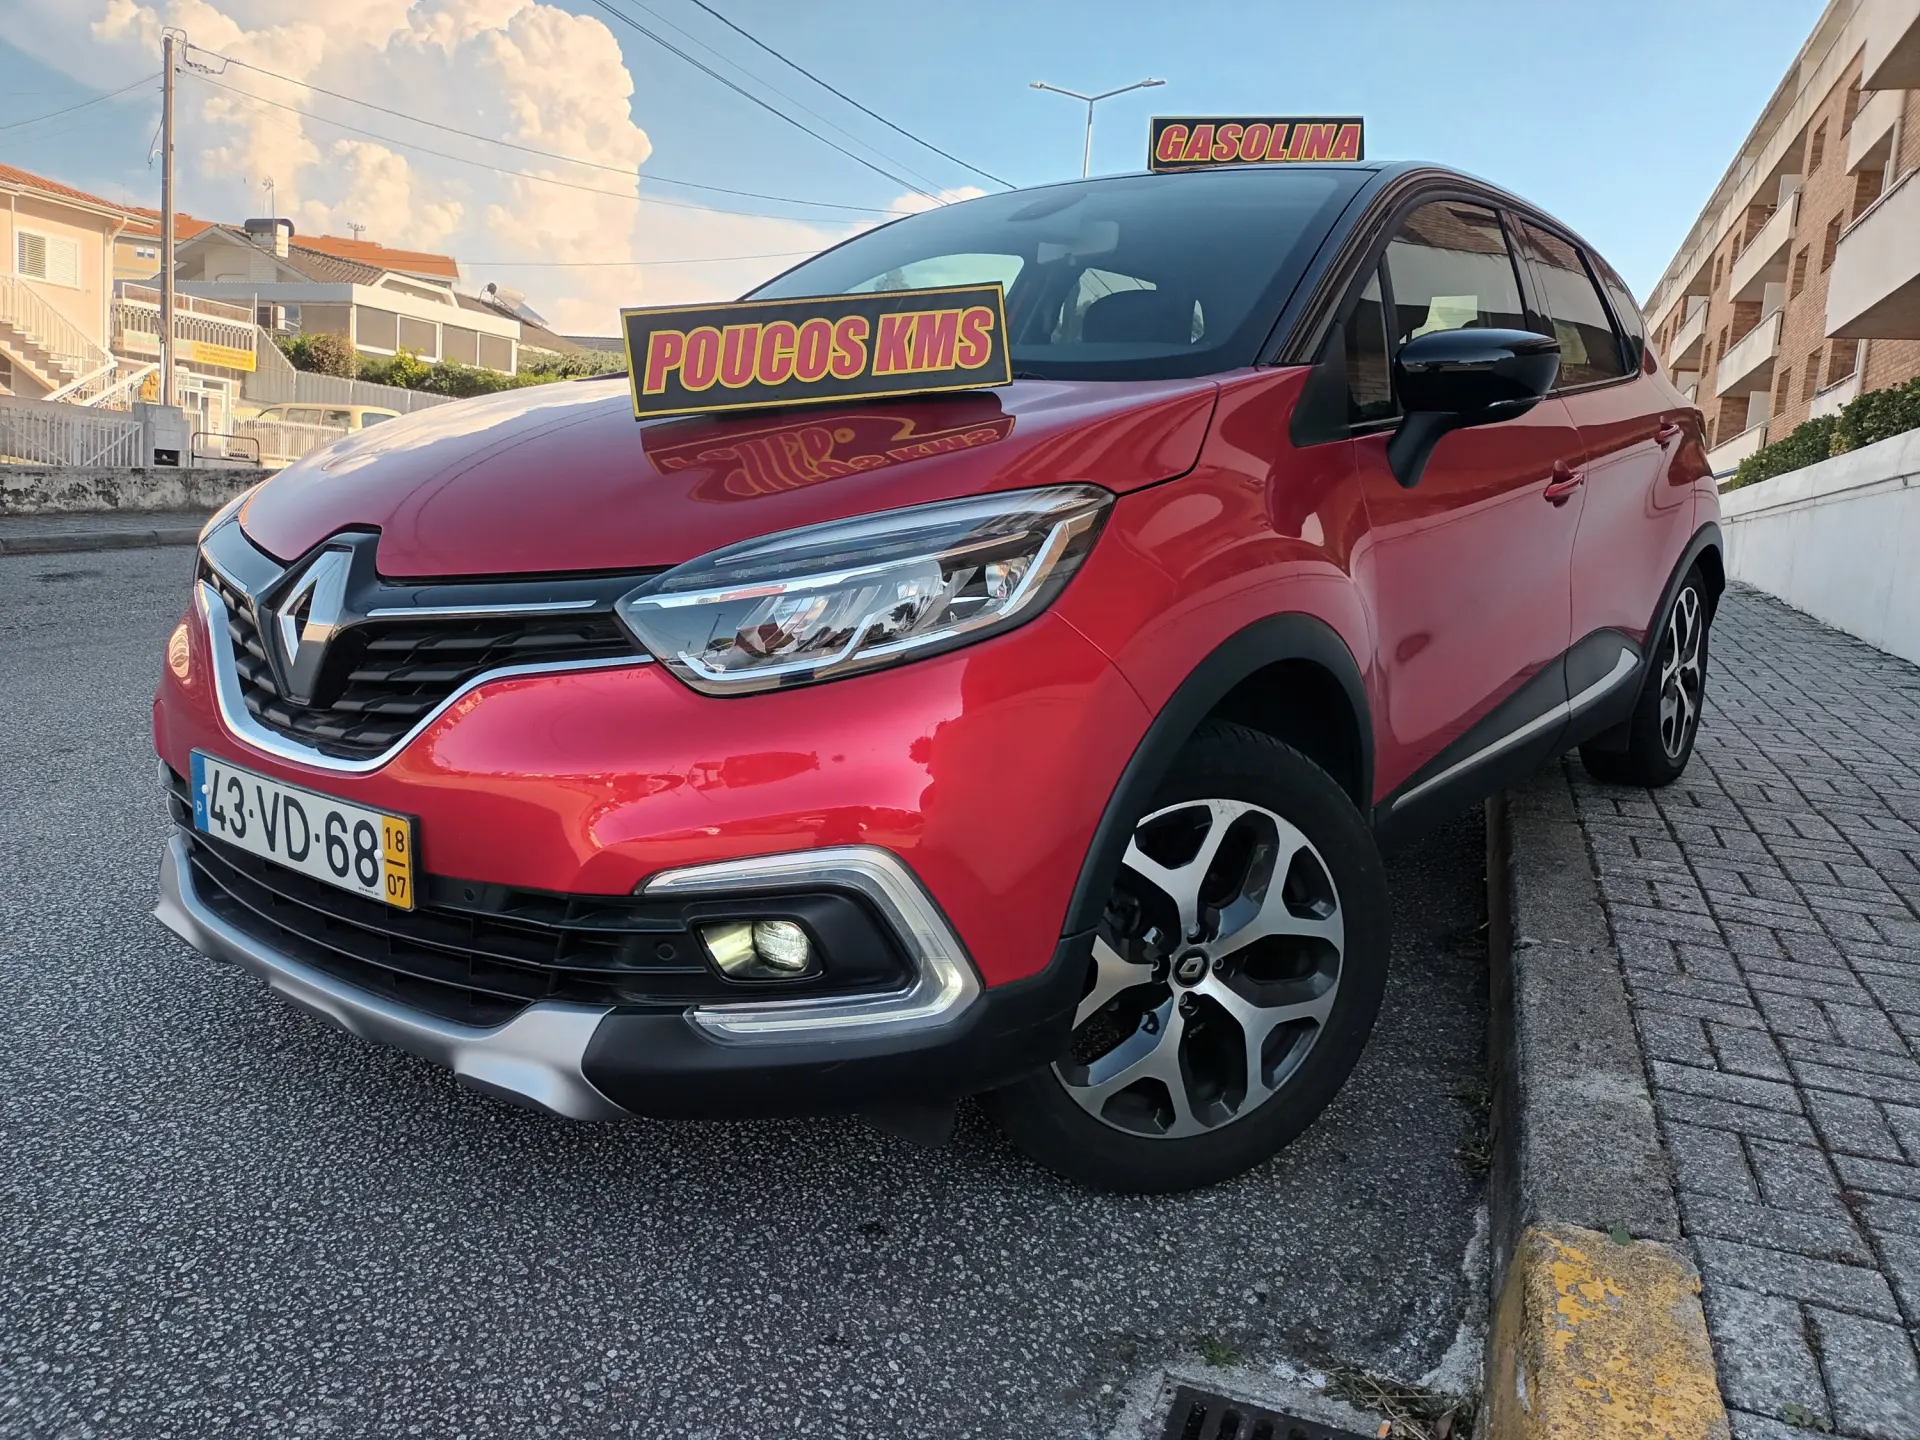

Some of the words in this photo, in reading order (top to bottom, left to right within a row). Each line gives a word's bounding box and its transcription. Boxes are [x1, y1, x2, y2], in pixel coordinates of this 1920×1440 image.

[1156, 123, 1362, 162] GASOLINA
[642, 315, 869, 395] POUCOS
[871, 306, 995, 377] KMS
[385, 827, 405, 853] 18
[387, 873, 406, 899] 07
